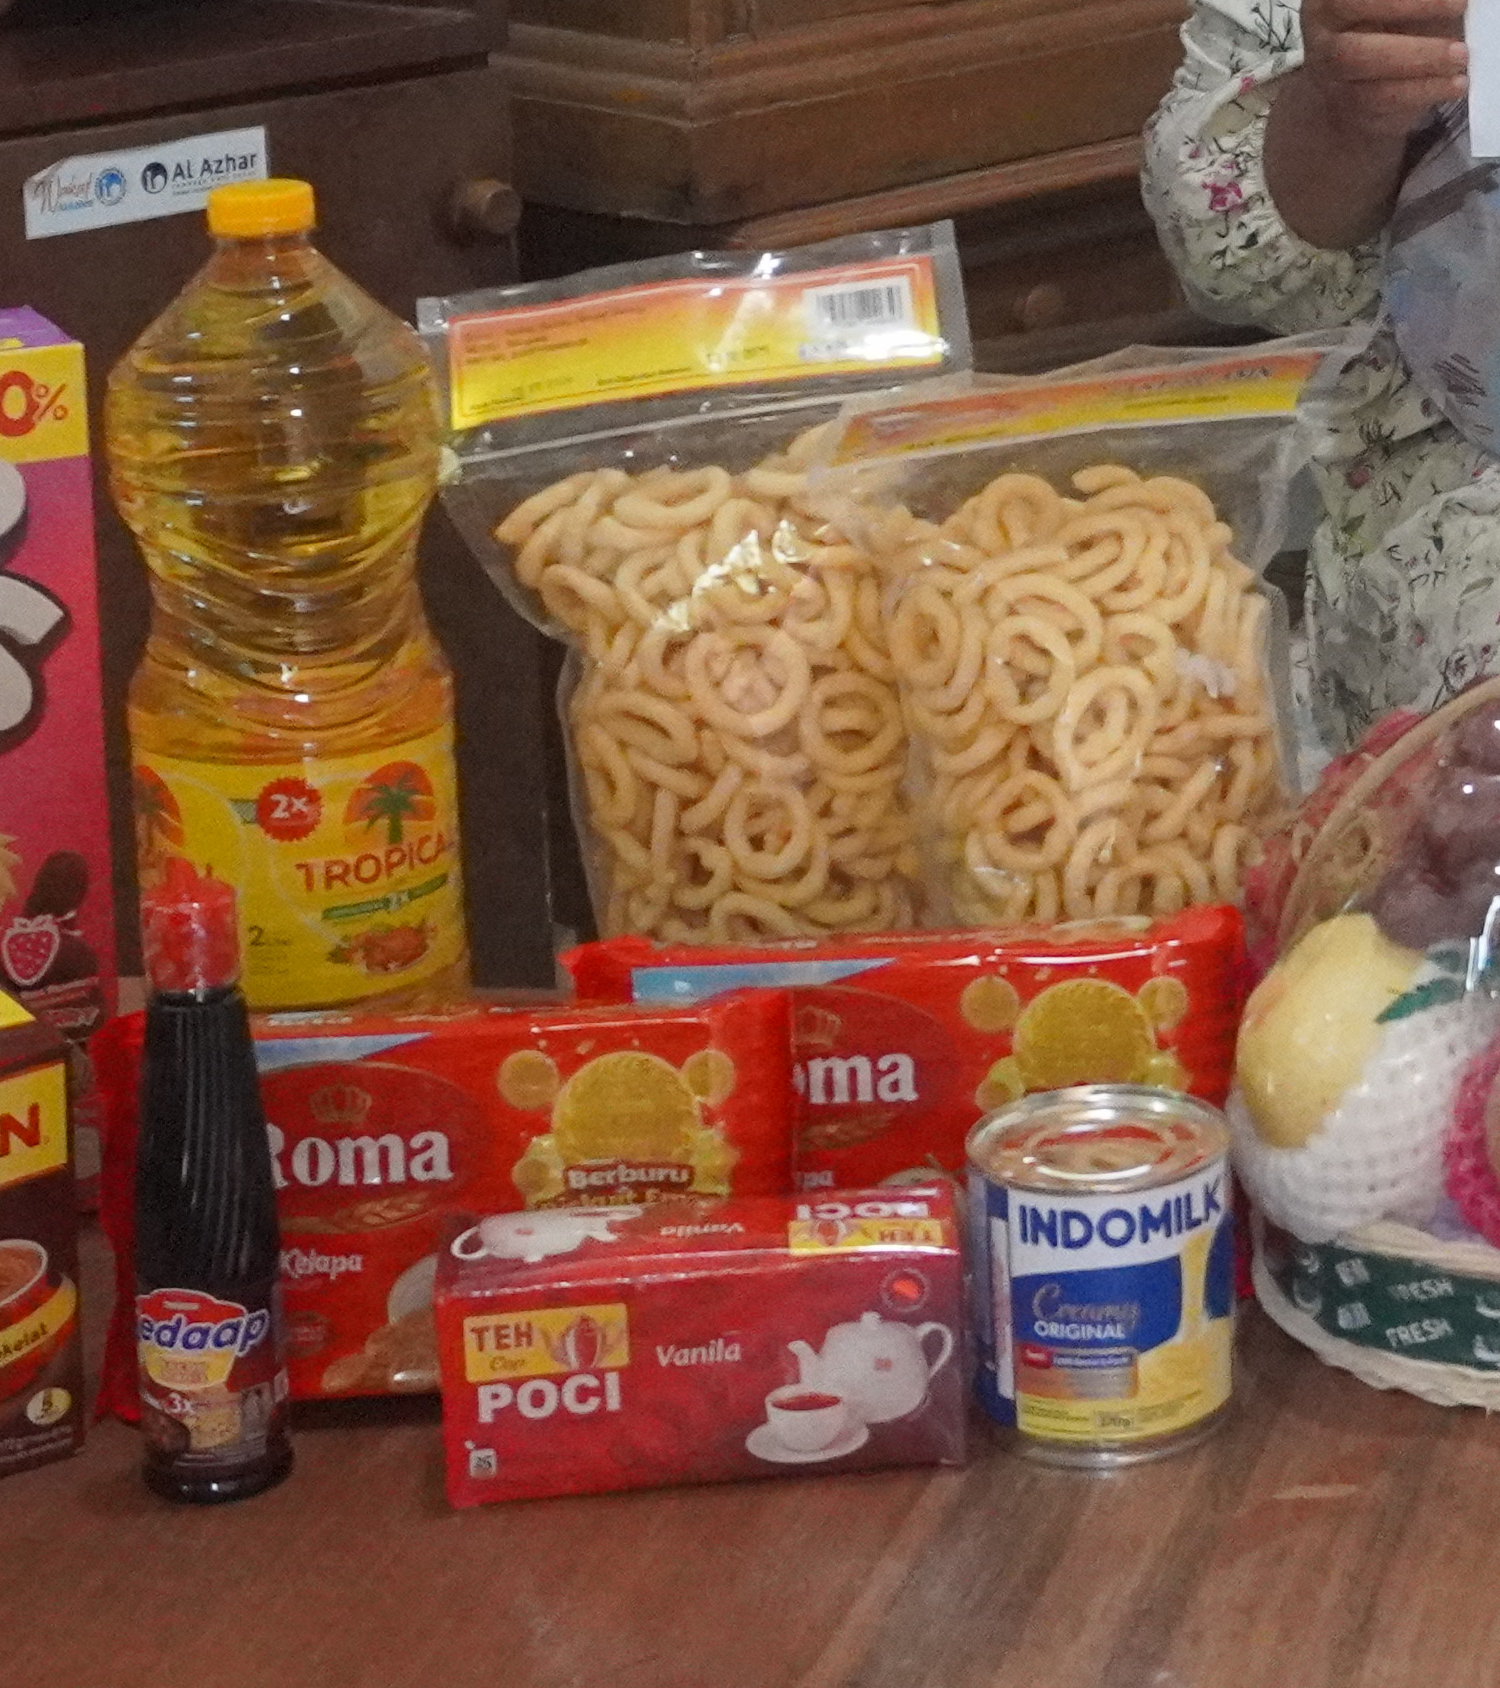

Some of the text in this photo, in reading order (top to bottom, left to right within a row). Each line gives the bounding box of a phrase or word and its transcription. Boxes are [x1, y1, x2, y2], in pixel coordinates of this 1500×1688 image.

[200, 153, 258, 177] Azhar
[267, 1124, 454, 1188] Roma
[567, 1163, 689, 1189] Berburu
[1018, 1176, 1220, 1249] INDOMILK
[470, 1322, 534, 1352] TEH
[1033, 1320, 1126, 1341] ORIGINAL
[1385, 1317, 1454, 1348] FRESH
[655, 1339, 743, 1368] Vanila
[477, 1371, 622, 1423] POCI
